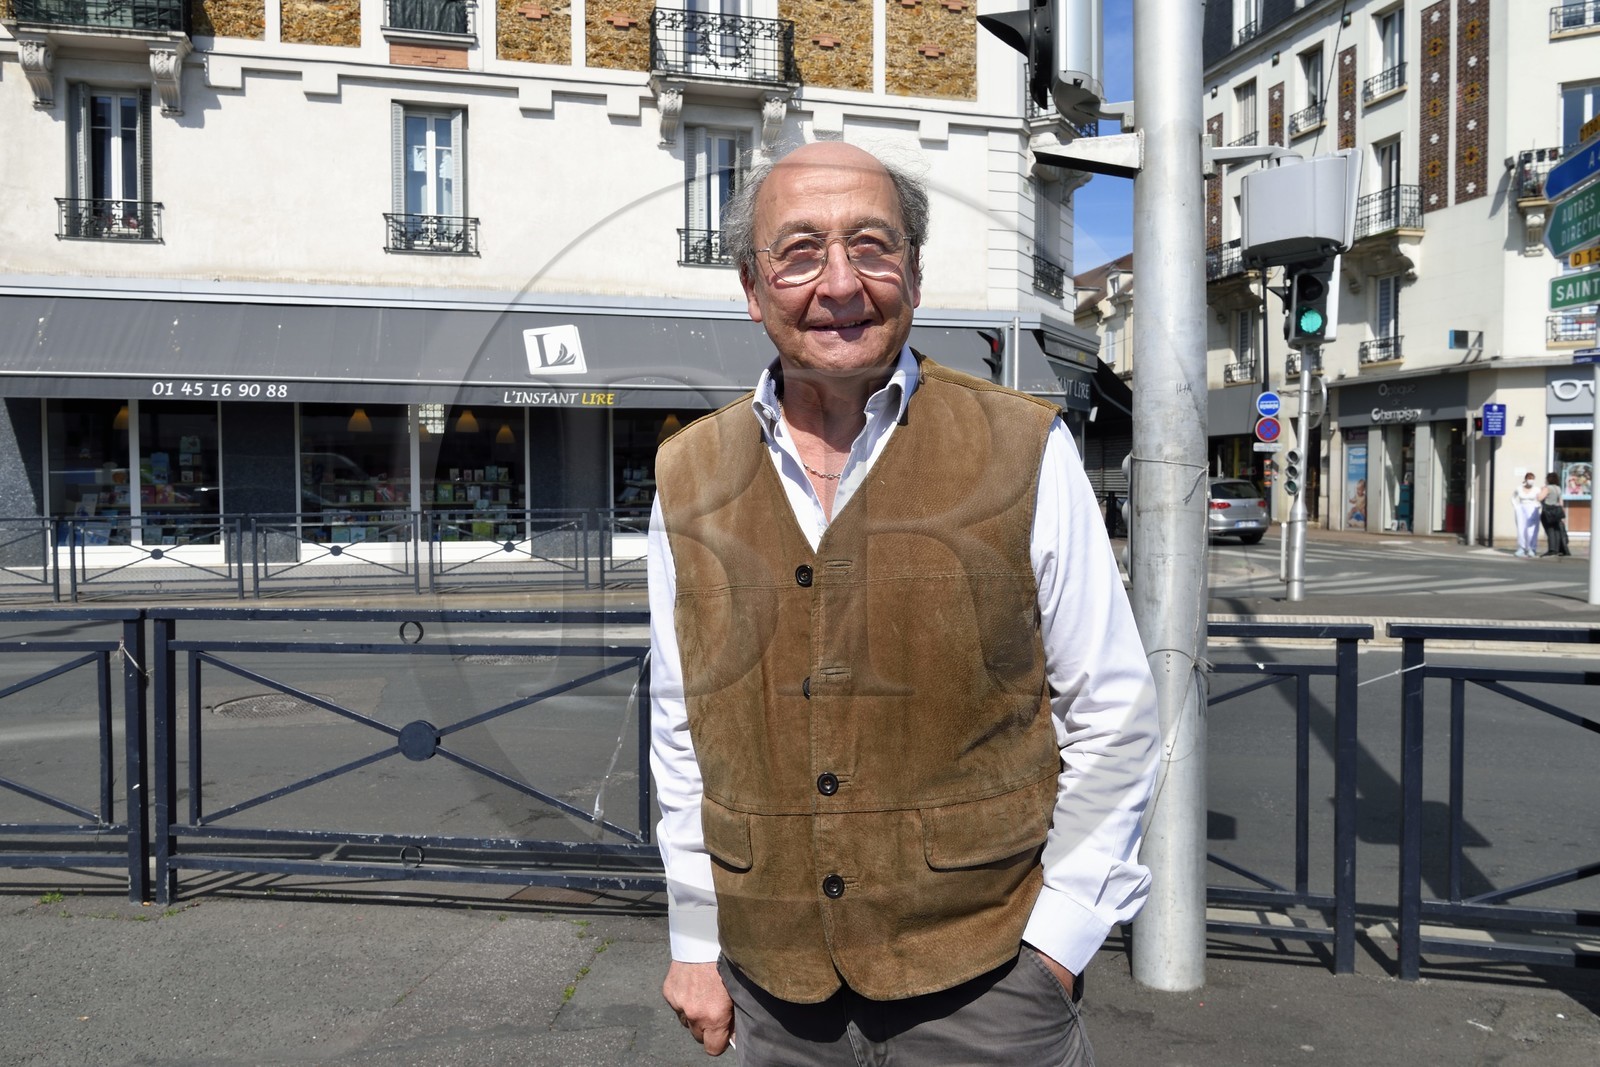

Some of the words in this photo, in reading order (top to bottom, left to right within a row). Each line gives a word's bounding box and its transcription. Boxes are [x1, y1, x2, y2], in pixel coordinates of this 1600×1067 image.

[1562, 193, 1595, 225] AUTRES
[1574, 253, 1582, 266] D
[1556, 278, 1600, 302] SAINT
[152, 382, 174, 396] 01
[181, 382, 203, 396] 45
[210, 383, 232, 397] 16
[238, 383, 260, 398] 90
[266, 384, 288, 398] 88
[503, 391, 579, 404] L'INSTANT
[581, 392, 615, 406] LIRE
[1371, 407, 1422, 423] Champigny
